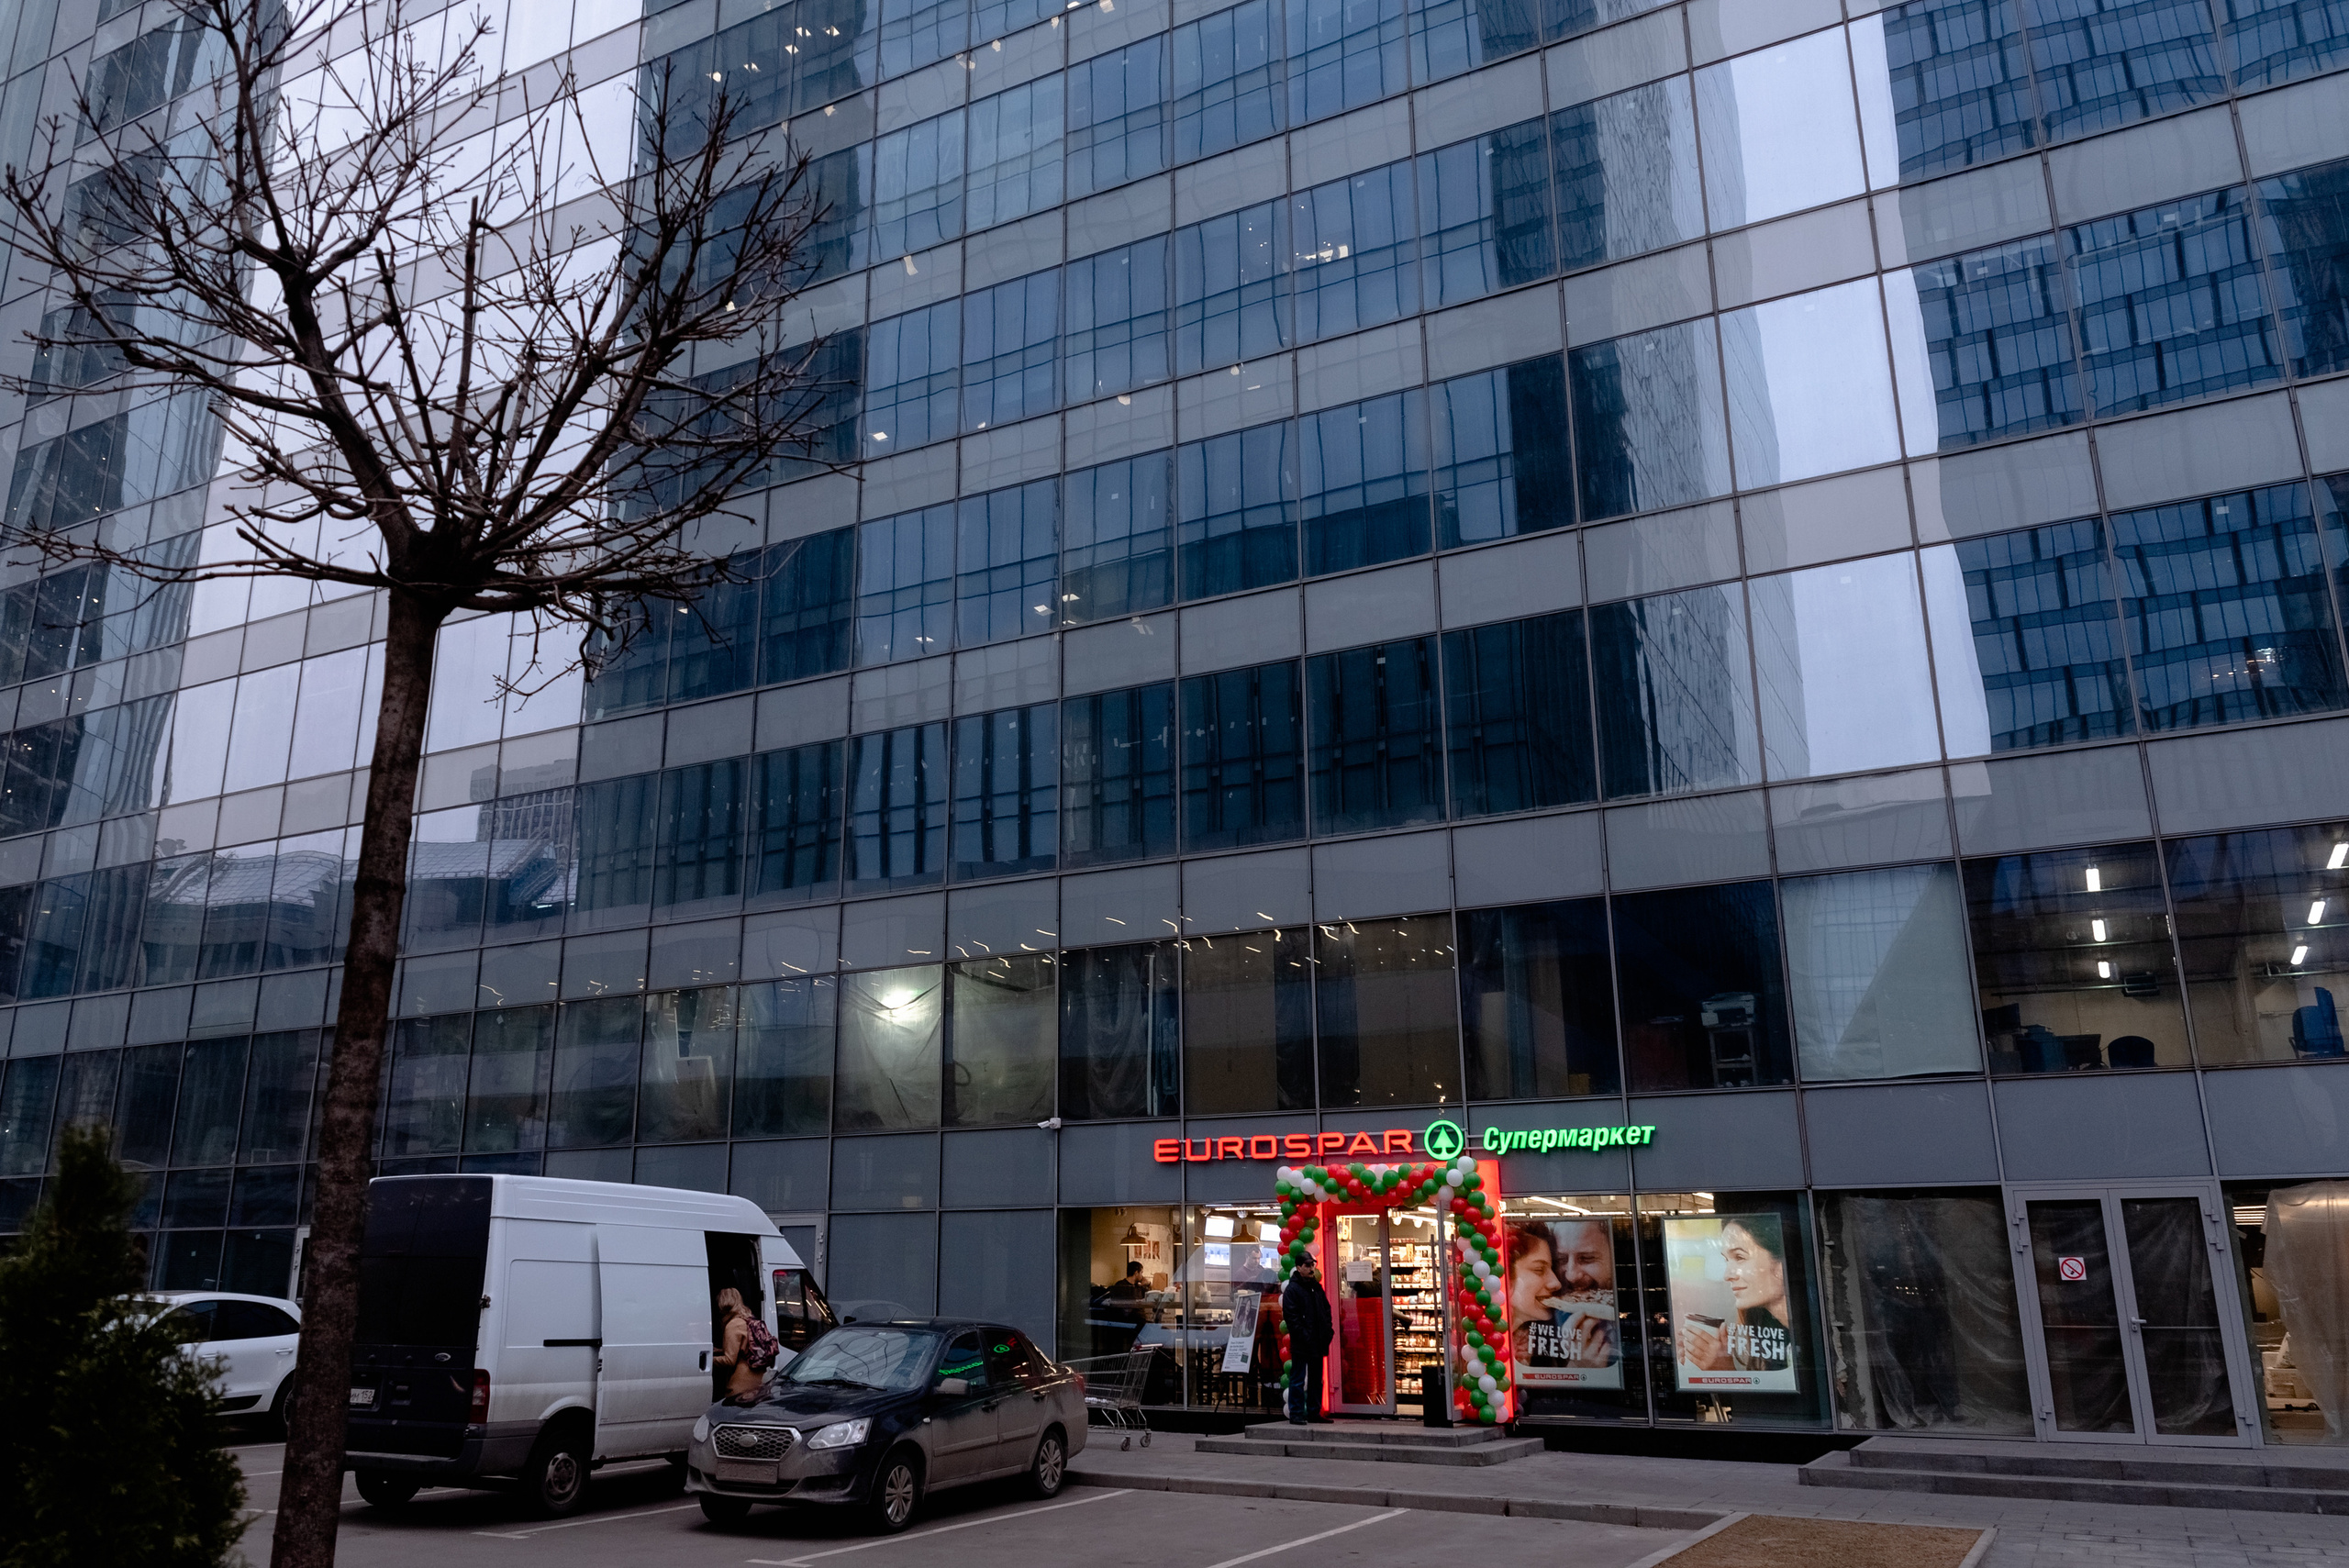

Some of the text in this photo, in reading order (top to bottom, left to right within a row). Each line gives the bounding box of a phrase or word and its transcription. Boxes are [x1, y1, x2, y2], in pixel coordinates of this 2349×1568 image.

[1153, 1129, 1413, 1162] EUROSPAR
[1483, 1125, 1656, 1155] Супермаркет
[1529, 1322, 1582, 1340] #WE LOVE
[1727, 1322, 1785, 1340] #WE LOVE
[1528, 1335, 1582, 1361] FRESH
[1727, 1336, 1785, 1361] FRESH
